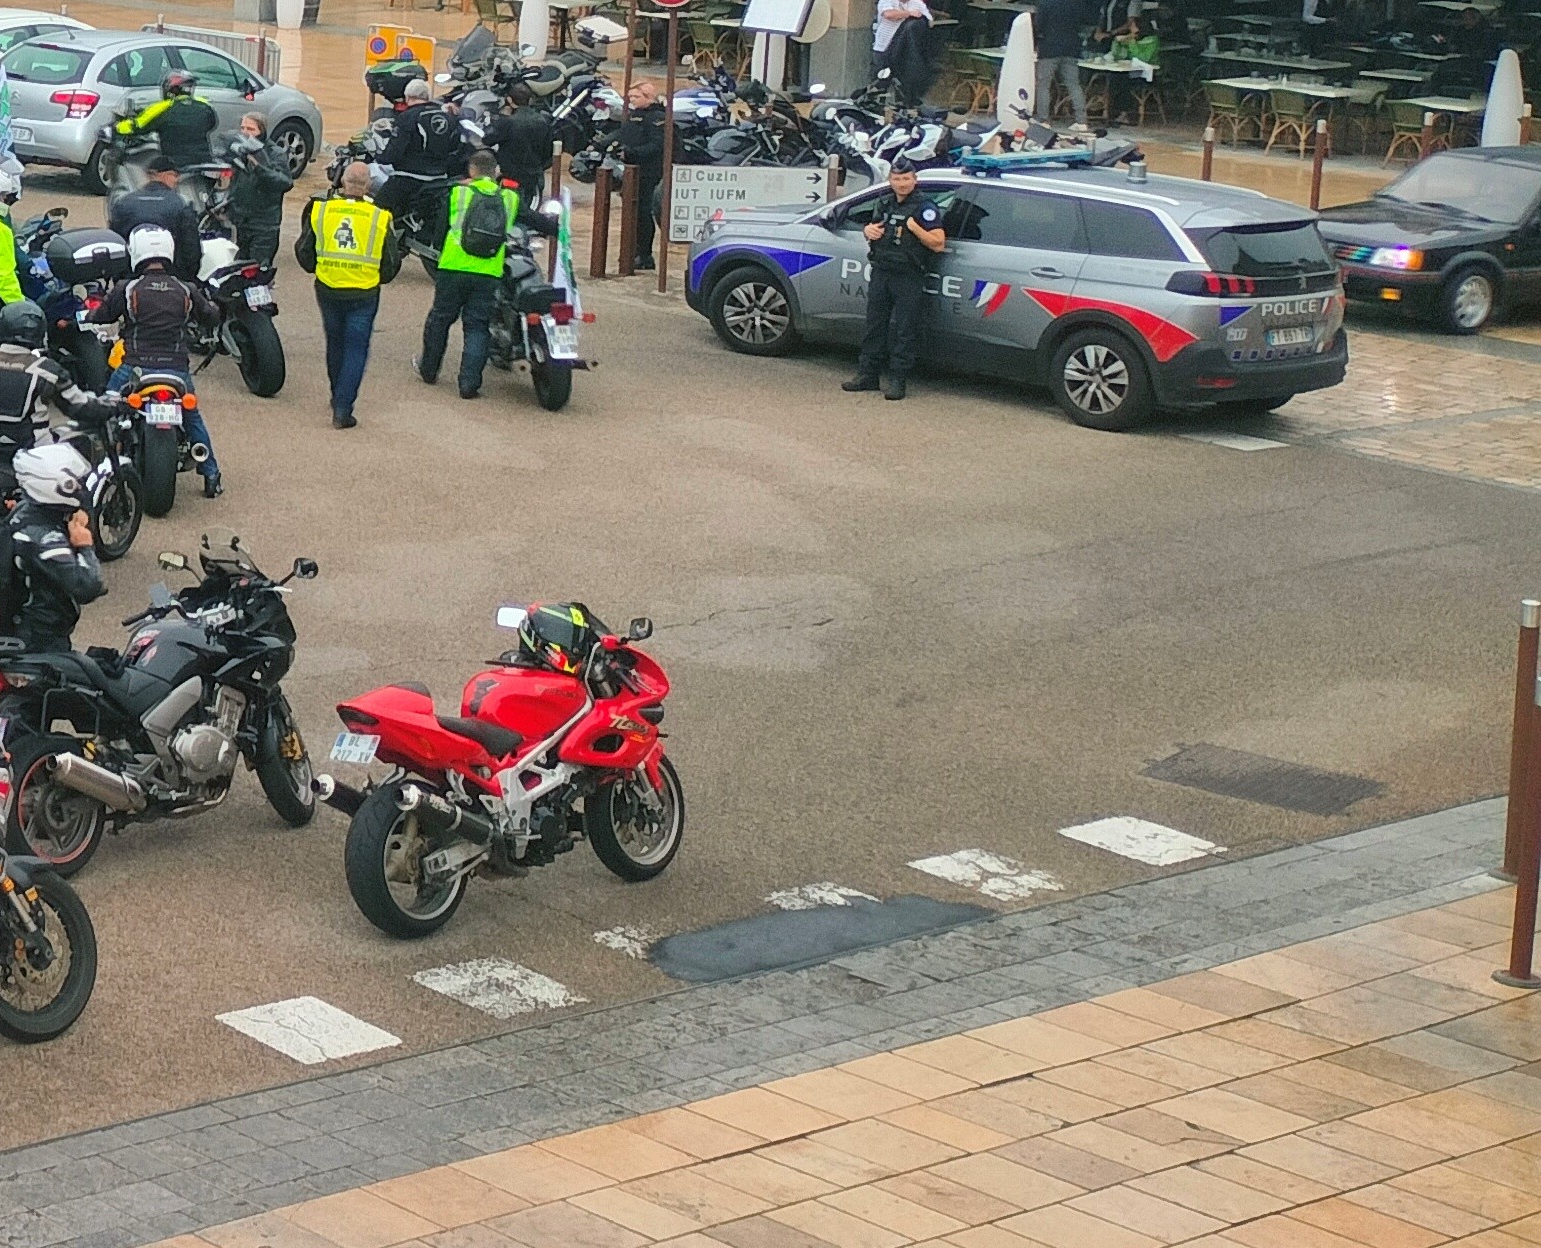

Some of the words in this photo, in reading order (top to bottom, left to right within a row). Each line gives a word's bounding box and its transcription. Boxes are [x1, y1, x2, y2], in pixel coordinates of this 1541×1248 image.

[675, 188, 700, 201] IUT
[710, 188, 746, 201] IUFM
[1261, 298, 1317, 318] POLICE
